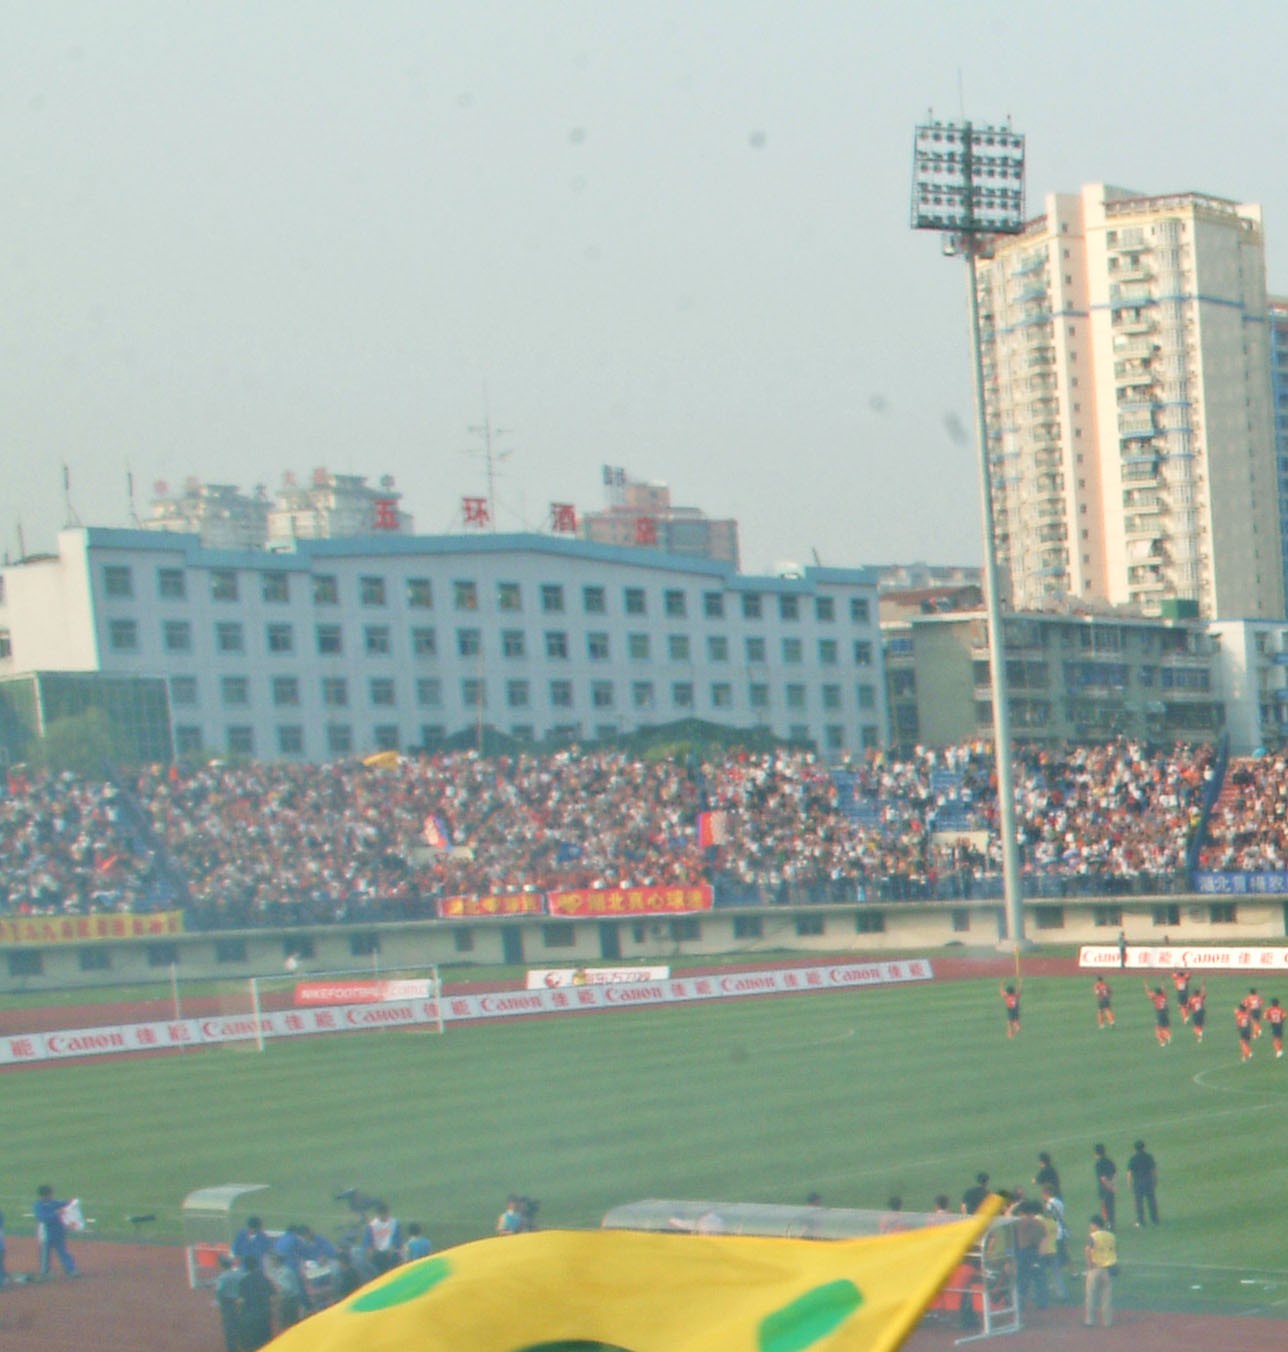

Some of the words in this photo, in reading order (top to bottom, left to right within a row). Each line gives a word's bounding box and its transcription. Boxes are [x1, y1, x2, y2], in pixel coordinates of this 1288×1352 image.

[1138, 951, 1173, 965] 佳能
[1182, 951, 1230, 964] Canon
[1238, 952, 1273, 965] 佳能
[46, 1031, 125, 1054] Canon
[202, 1020, 274, 1038] Canon
[346, 1007, 413, 1025] Canon
[479, 994, 543, 1013] Canon
[605, 985, 663, 1002] Canon
[720, 974, 776, 993] Canon
[828, 968, 881, 983] Canon
